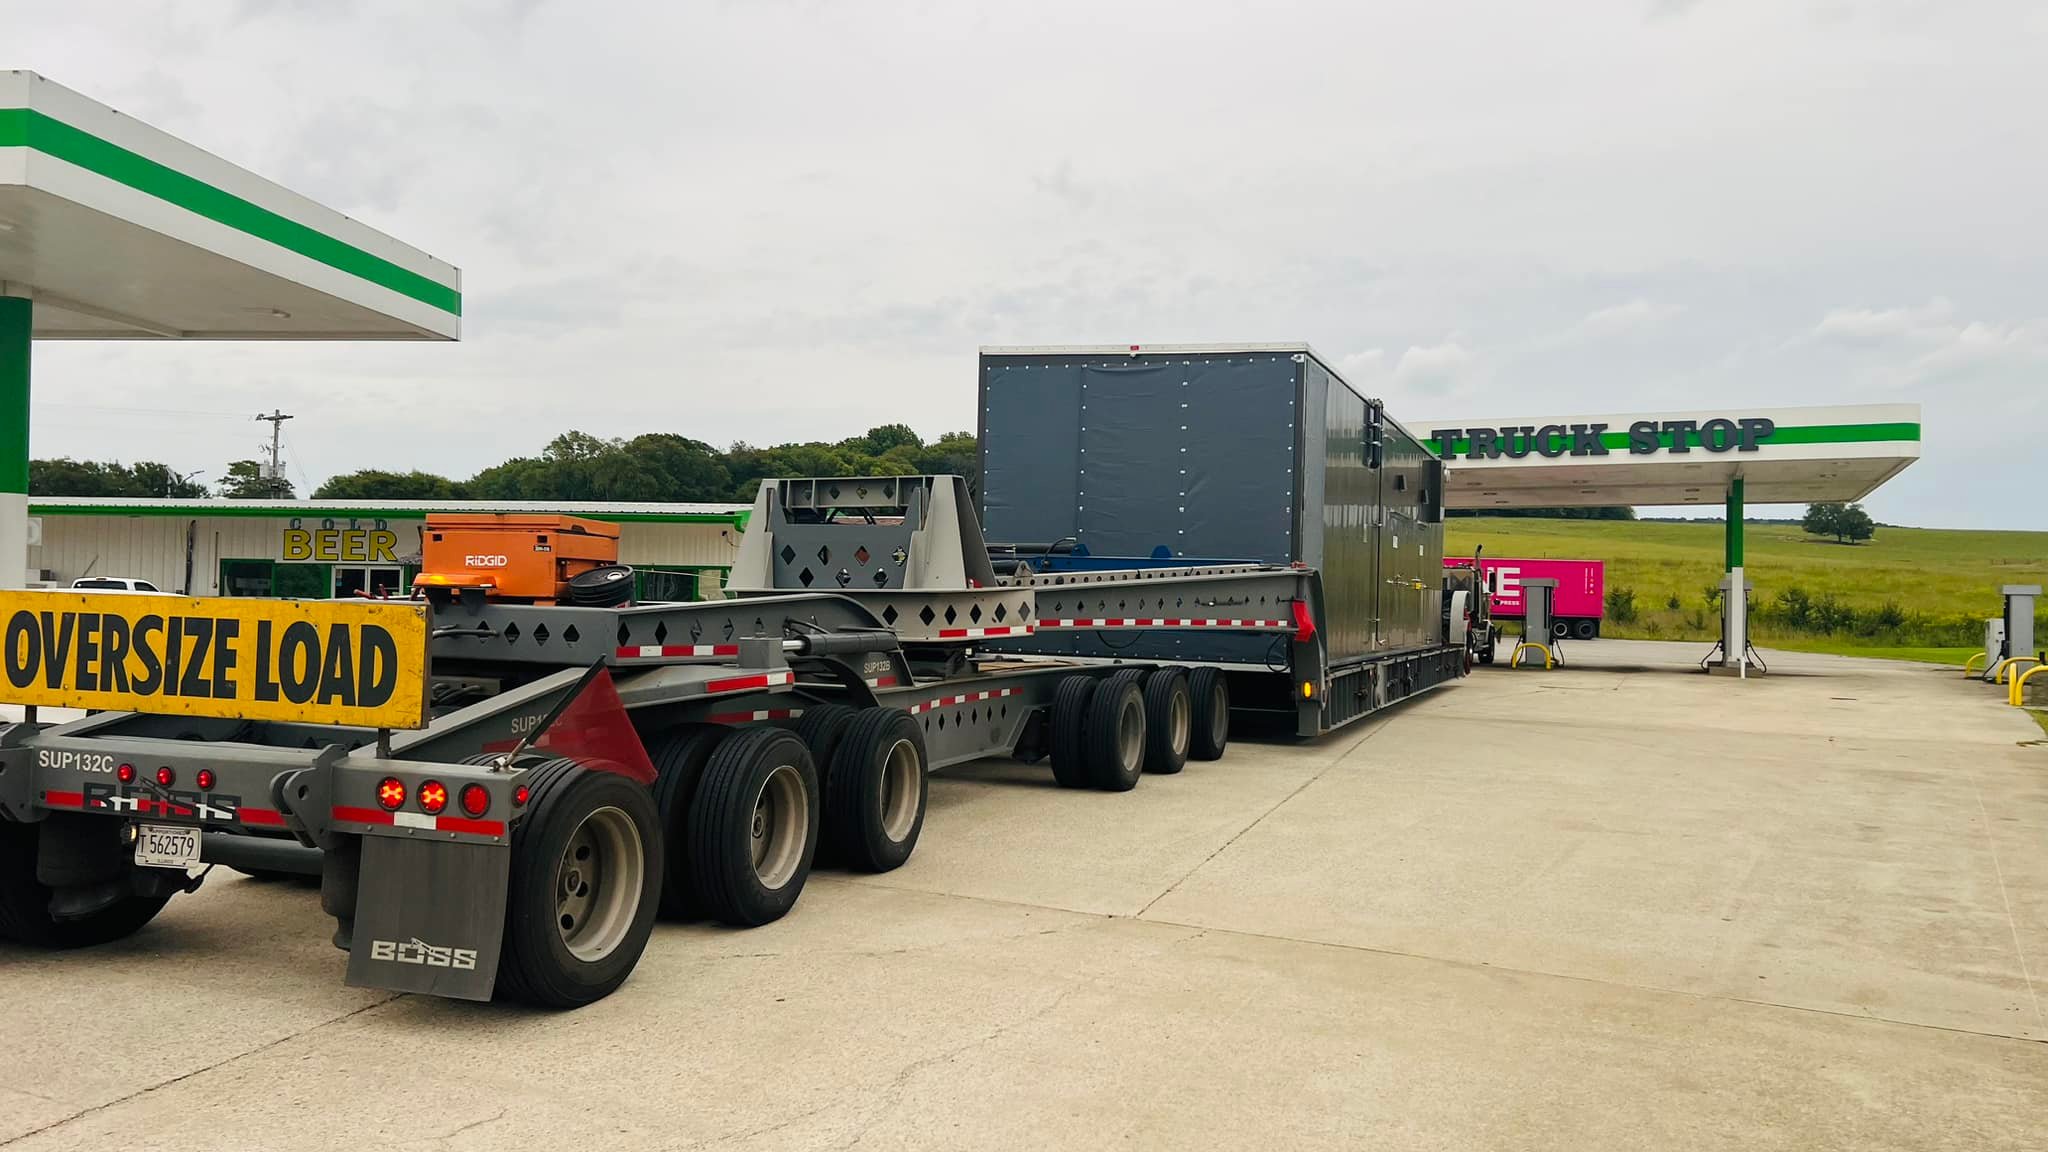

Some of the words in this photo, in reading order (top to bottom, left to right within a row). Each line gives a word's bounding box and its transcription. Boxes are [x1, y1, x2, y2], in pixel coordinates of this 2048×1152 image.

[1431, 424, 1609, 460] TRUCK
[1629, 418, 1775, 455] STOP
[289, 518, 388, 530] COLD
[283, 529, 398, 561] BEER
[4, 610, 240, 699] OVERSIZE
[254, 619, 398, 707] LOAD
[39, 750, 114, 773] SUP132C
[139, 834, 147, 853] T
[150, 834, 195, 857] 562579
[370, 937, 478, 970] BOSS
